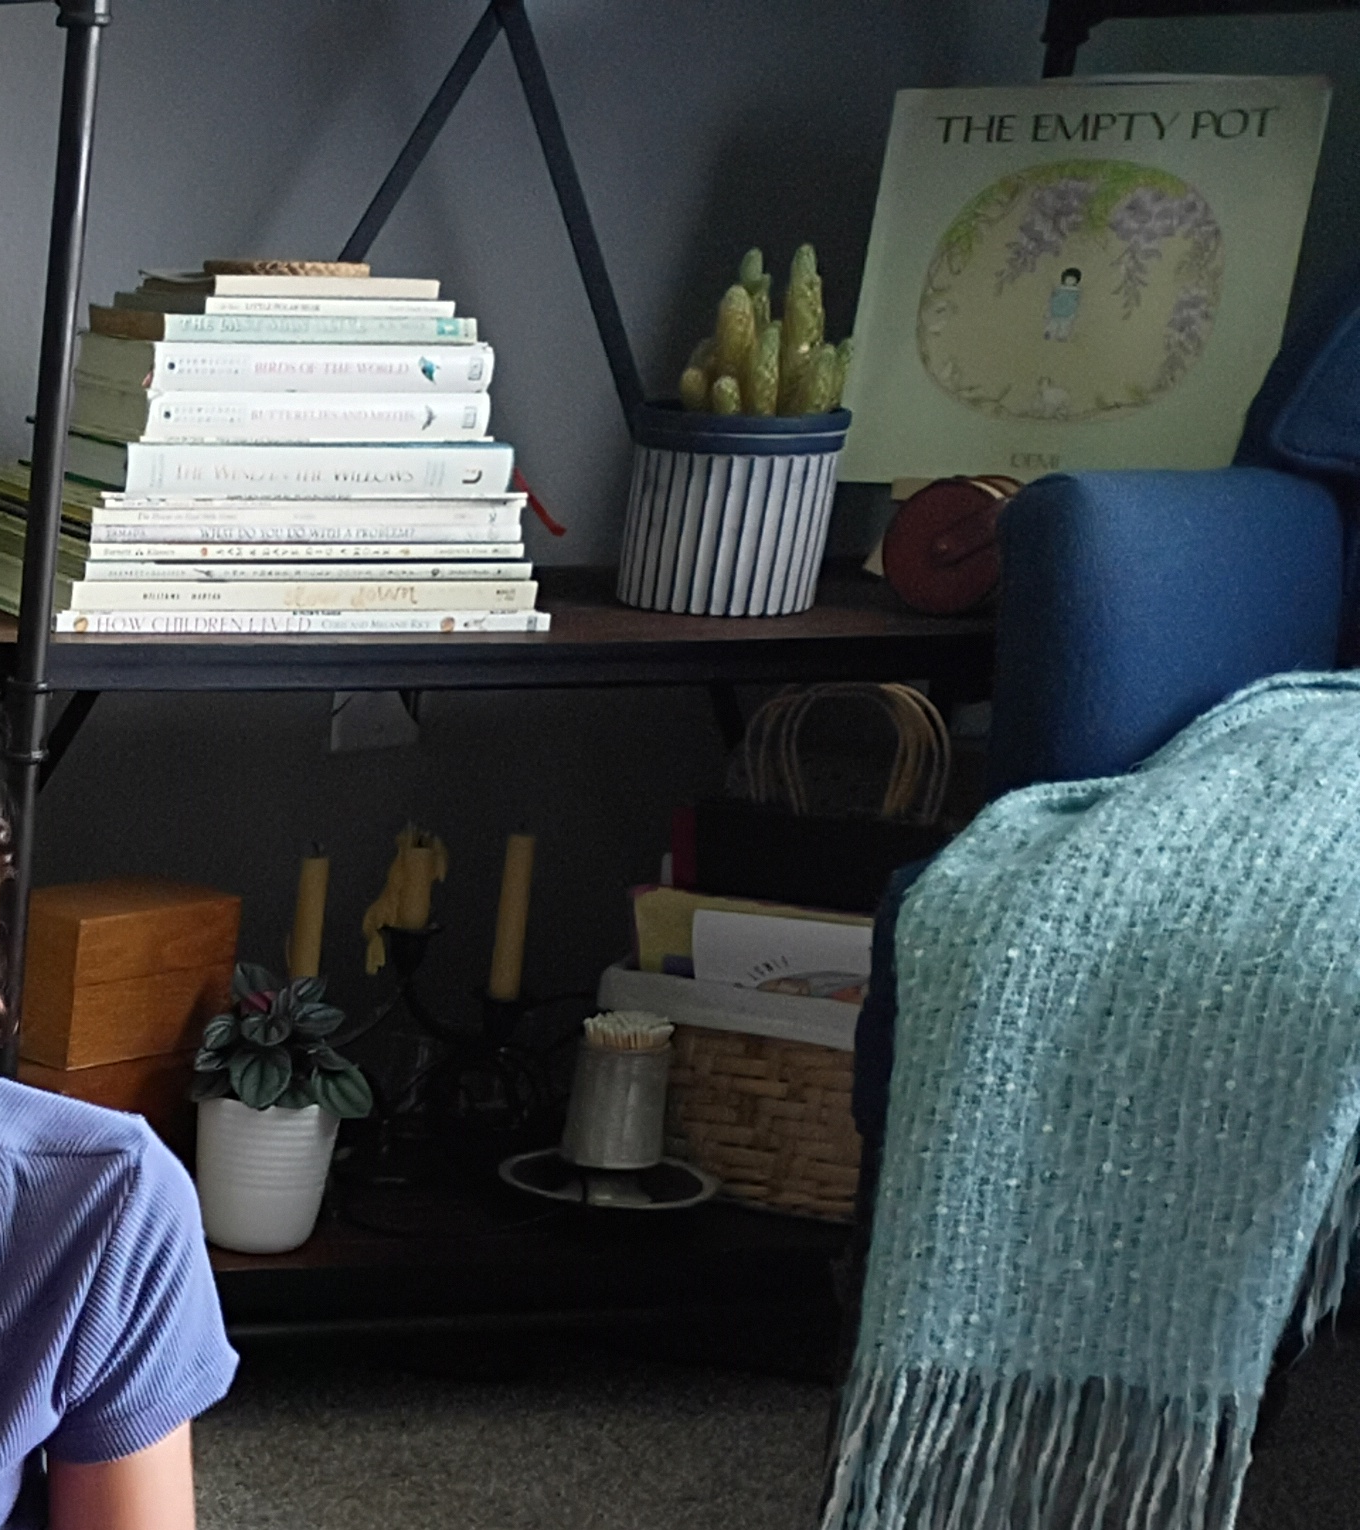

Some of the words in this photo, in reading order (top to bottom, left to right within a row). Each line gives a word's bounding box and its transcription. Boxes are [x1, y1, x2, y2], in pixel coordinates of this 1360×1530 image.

[935, 114, 1019, 145] THE
[1031, 110, 1180, 143] EMPTY
[1191, 105, 1278, 140] POT
[254, 362, 296, 375] BIRDS
[299, 362, 314, 375] OF
[324, 362, 349, 375] THE
[356, 362, 410, 375] WORLD
[333, 467, 414, 483] WILLOWS
[199, 527, 233, 540] WHAT
[238, 528, 254, 540] DO
[260, 528, 284, 540] YOU
[287, 528, 306, 540] DO
[310, 527, 340, 540] WITH
[342, 528, 352, 539] A
[354, 527, 416, 540] PROBLEM?
[96, 616, 145, 633] HOW
[151, 616, 244, 633] CHILDREN
[248, 616, 312, 633] LIVED
